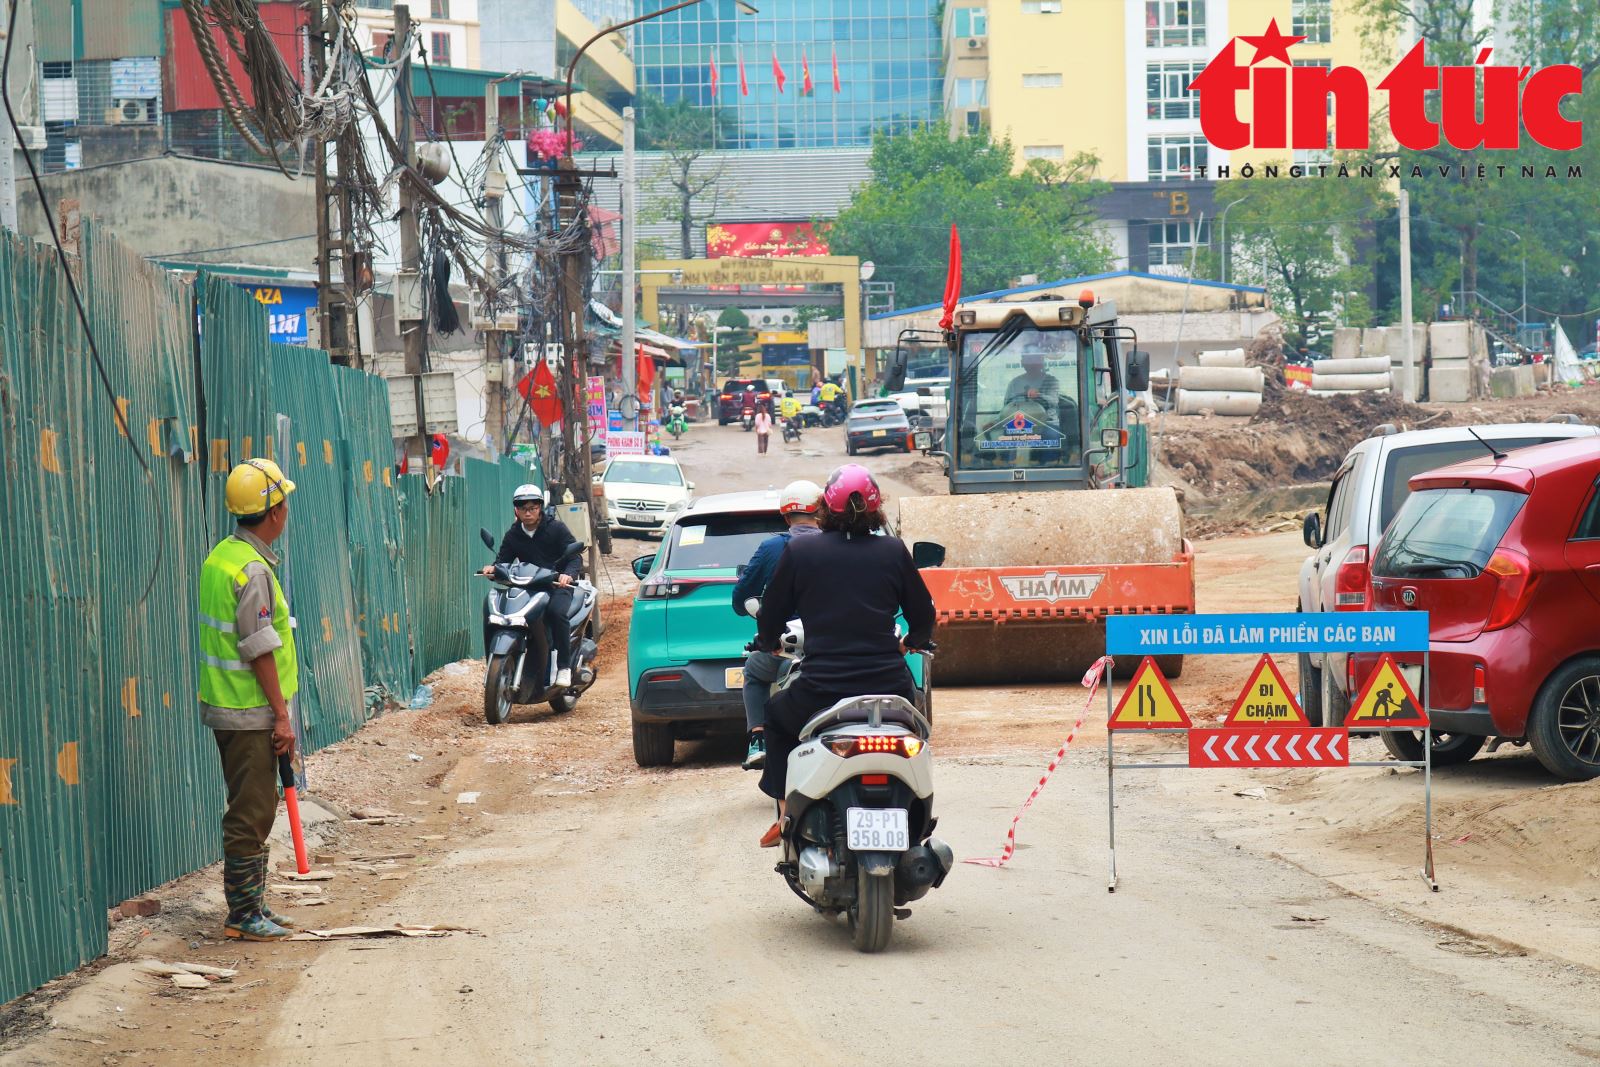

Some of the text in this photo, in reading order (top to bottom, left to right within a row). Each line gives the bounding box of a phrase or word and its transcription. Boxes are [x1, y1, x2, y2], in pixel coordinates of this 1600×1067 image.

[1169, 191, 1189, 215] B
[1019, 579, 1087, 597] HAMM
[1140, 629, 1169, 645] XIN
[1173, 622, 1198, 645] LỖI
[1203, 625, 1225, 644] ĐÃ
[1230, 624, 1264, 644] LÀM
[1324, 623, 1357, 643] CÁC
[1361, 626, 1396, 646] BẠN
[1259, 683, 1274, 697] ĐI
[1246, 702, 1288, 719] CHẬM
[856, 811, 900, 829] 29-P1
[851, 829, 905, 848] 358.08
